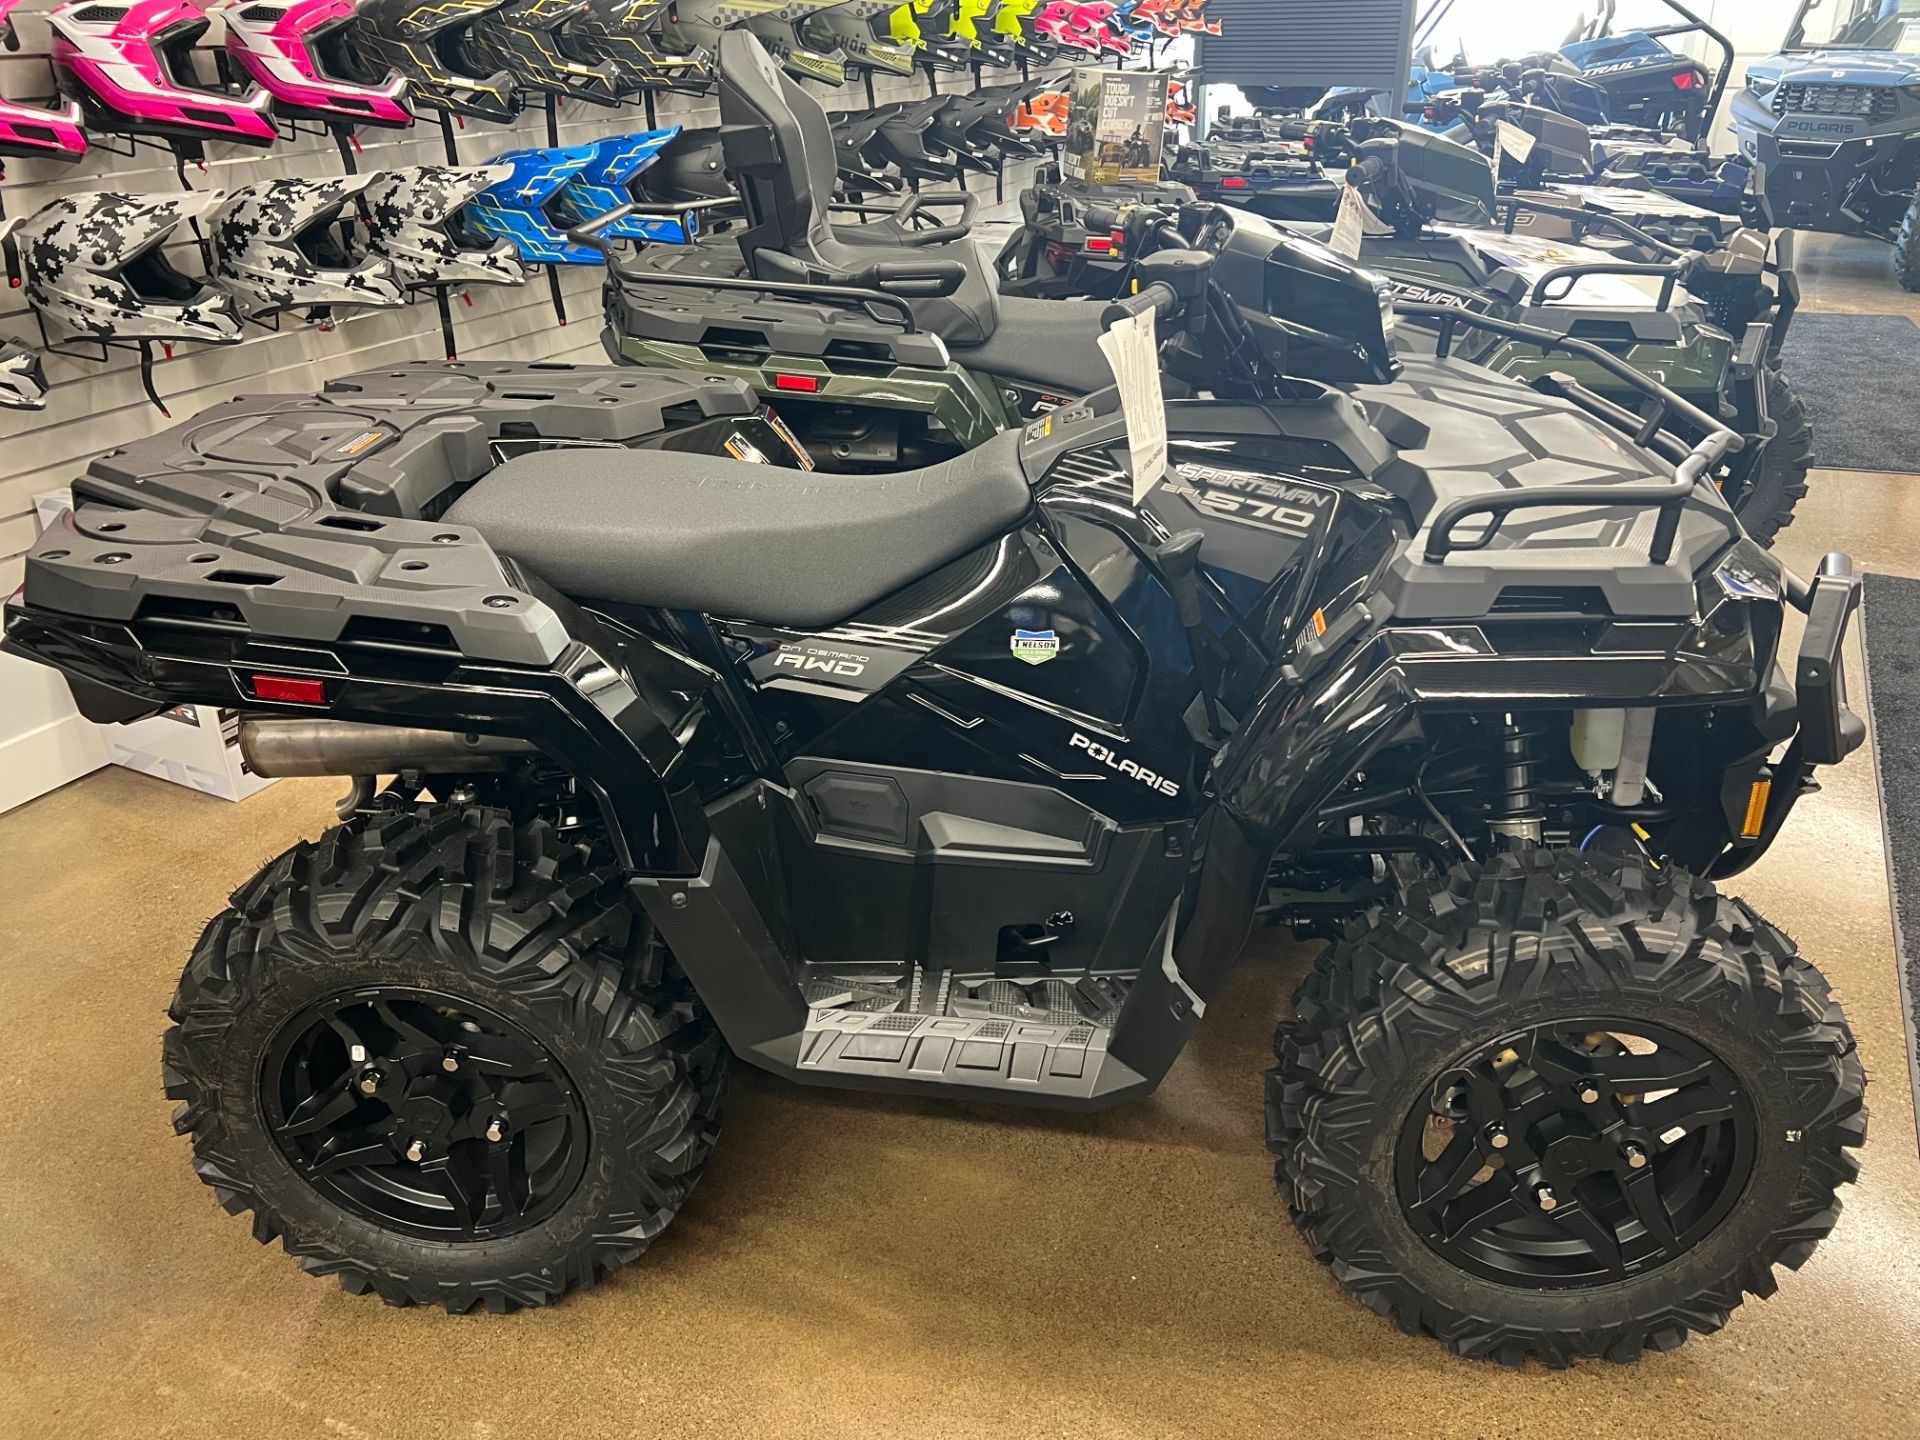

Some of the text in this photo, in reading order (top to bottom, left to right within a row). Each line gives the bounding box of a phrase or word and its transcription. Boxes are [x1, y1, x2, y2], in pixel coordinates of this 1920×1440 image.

[1582, 61, 1635, 78] TRAIL
[1105, 83, 1130, 95] TOUGH
[1104, 95, 1135, 107] DOESN'T
[1103, 107, 1118, 118] CUT
[1787, 121, 1854, 134] POLARIS
[1177, 463, 1331, 508] SPORTSMAN
[1160, 482, 1315, 528] EFI 570
[779, 644, 870, 663] ON DEMAND
[773, 653, 865, 677] AWD
[1069, 732, 1180, 797] POLARIS
